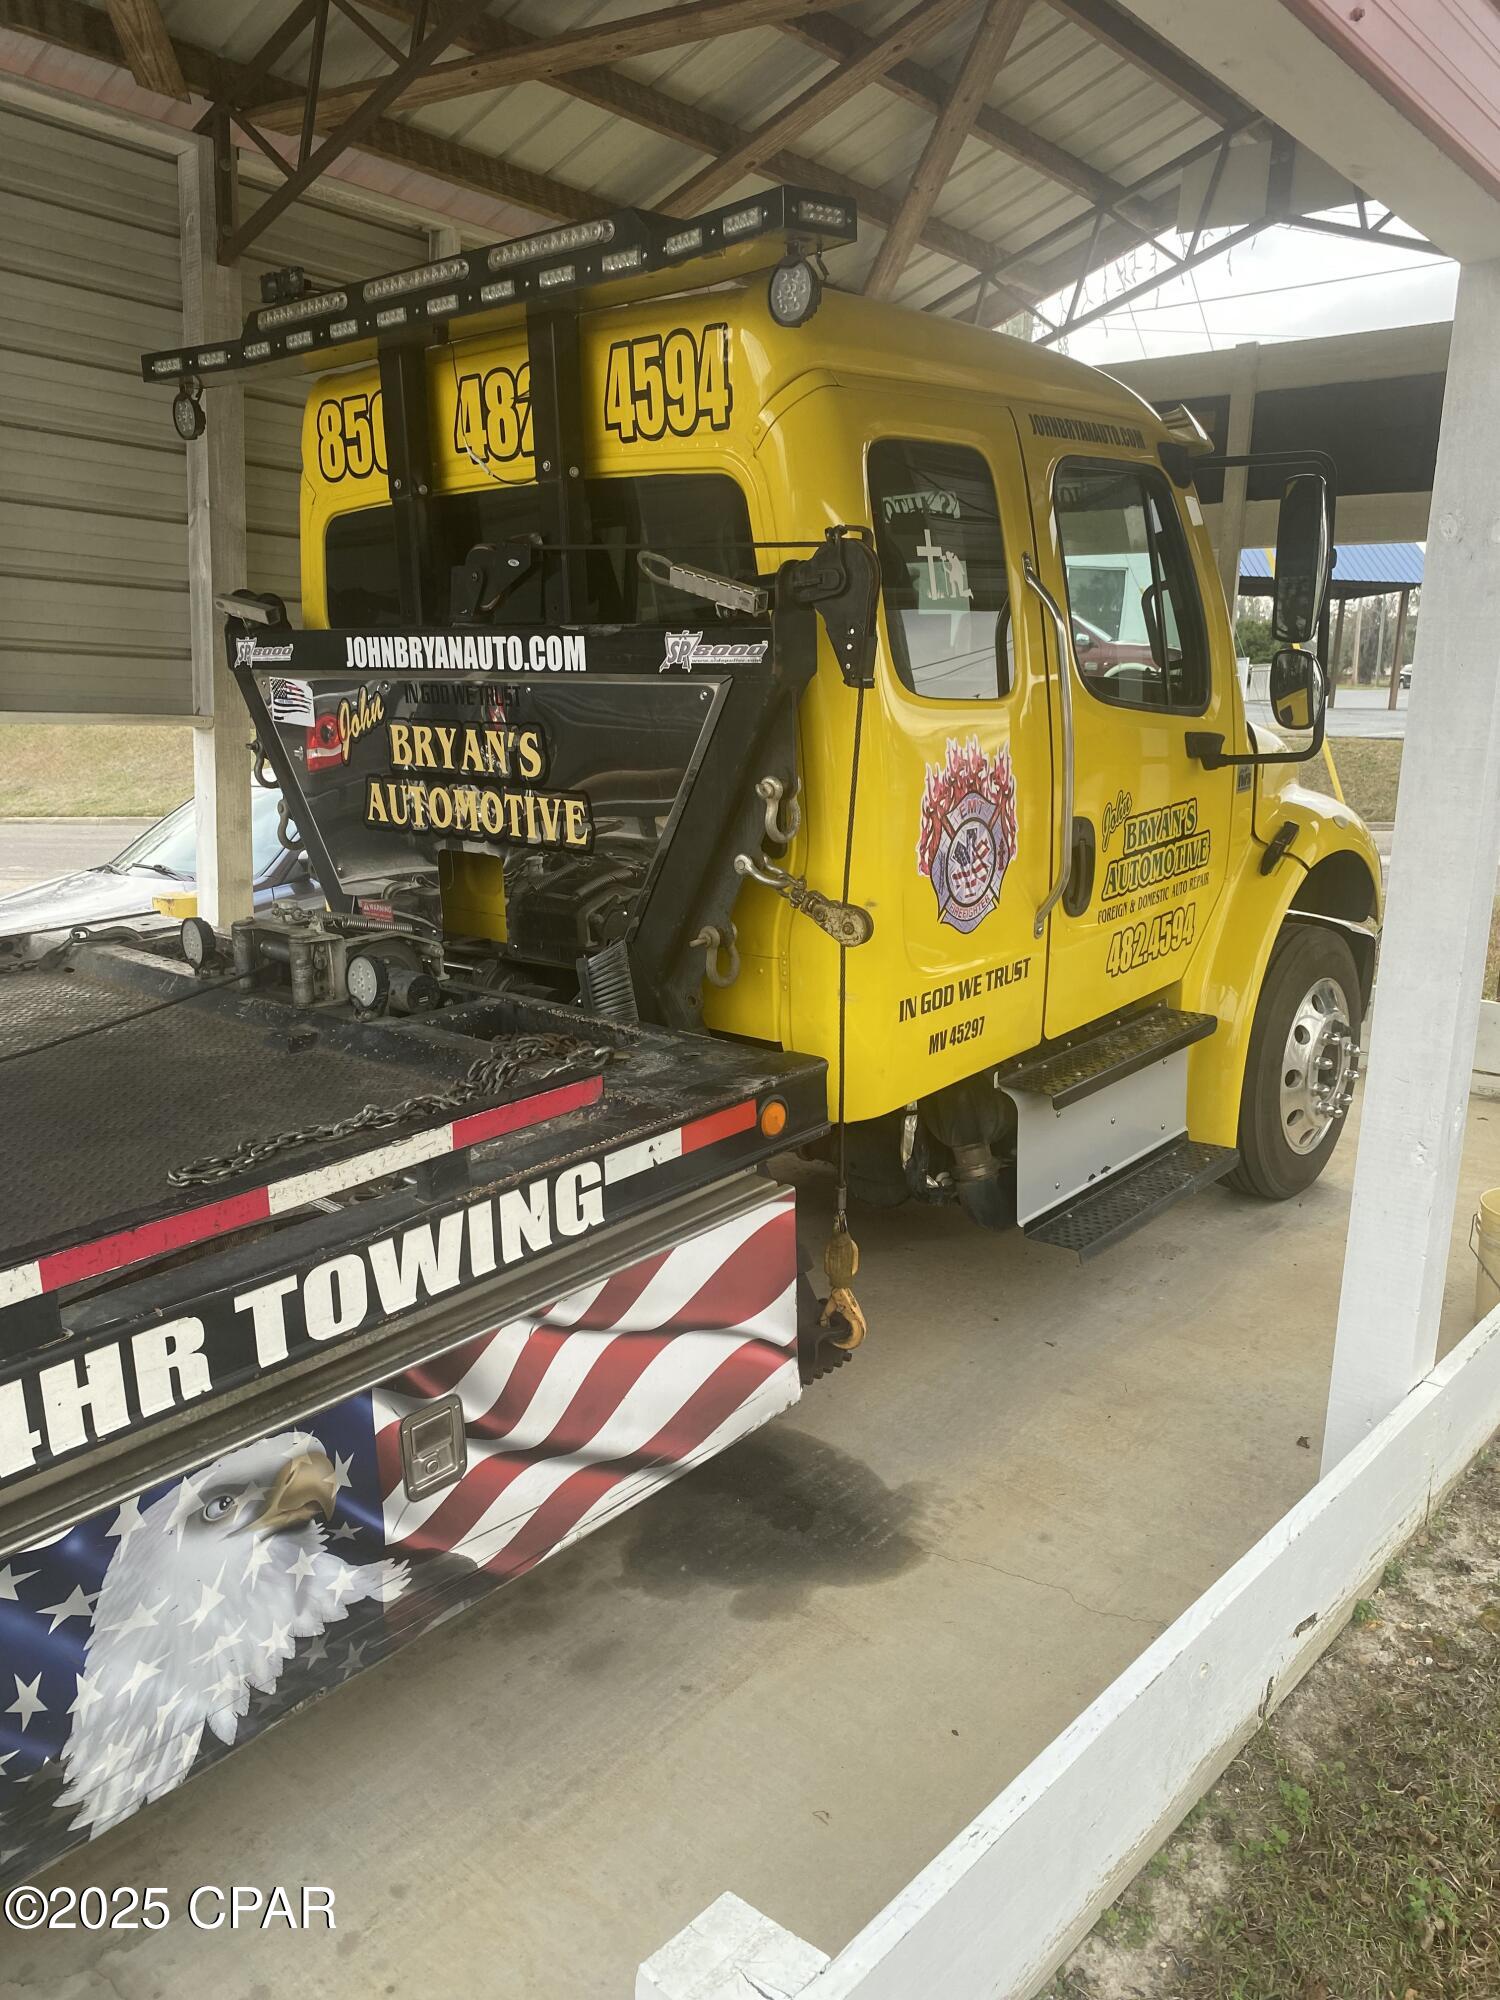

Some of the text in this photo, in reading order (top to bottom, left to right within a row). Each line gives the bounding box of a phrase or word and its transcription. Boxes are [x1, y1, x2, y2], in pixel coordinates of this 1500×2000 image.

[604, 322, 733, 444] 4594
[1028, 413, 1146, 449] JOHNBRYANAUTO.COM
[346, 635, 587, 672] JOHNBRYANAUTO.COM
[693, 645, 767, 656] 8000
[404, 683, 521, 707] IN GOD WE TRUST
[339, 685, 385, 762] John
[389, 723, 543, 779] BRYAN'S
[367, 782, 588, 846] AUTOMOTIVE
[958, 799, 986, 819] EMT
[1124, 799, 1197, 852] BRYAN'S
[1103, 832, 1210, 899] AUTOMOTIVE
[1098, 901, 1129, 925] FOREIGN
[1138, 886, 1170, 911] DOMESTIC
[1172, 879, 1188, 898] AUTO
[1189, 871, 1210, 891] REPAIR
[899, 957, 1032, 1023] IN GOD WE TRUST
[928, 1015, 985, 1056] MV 45297
[234, 1160, 606, 1369] TOWING
